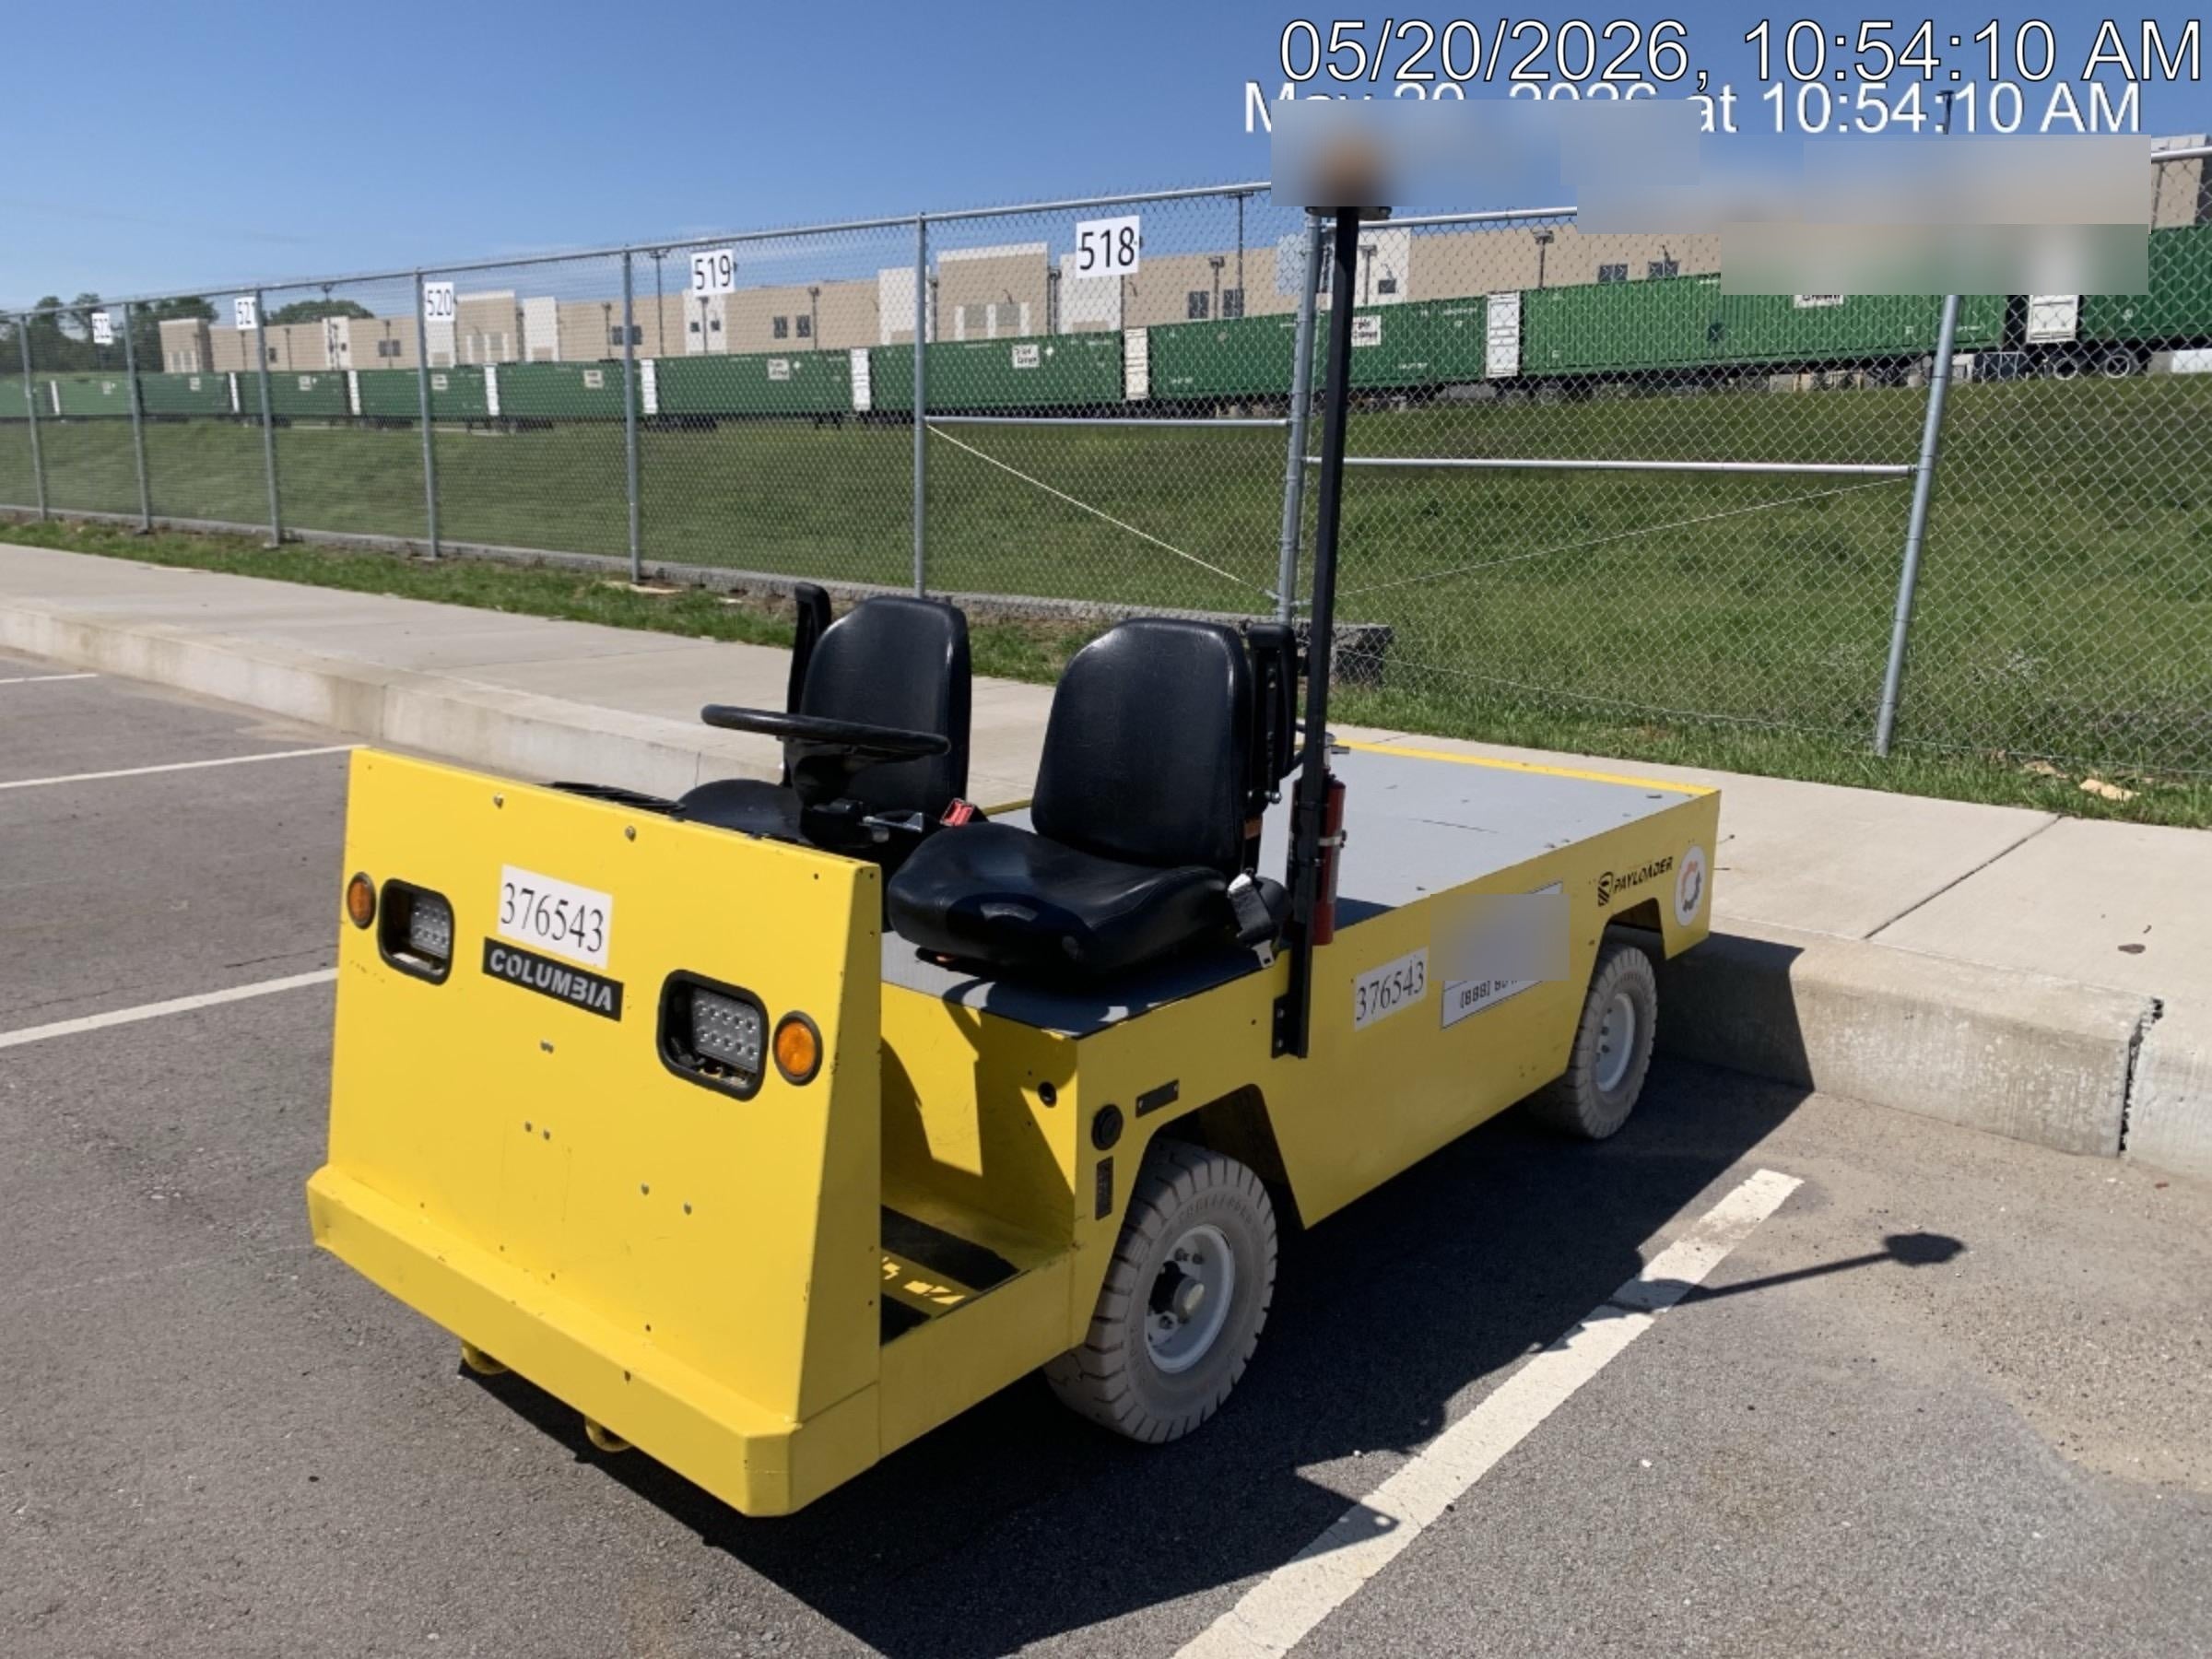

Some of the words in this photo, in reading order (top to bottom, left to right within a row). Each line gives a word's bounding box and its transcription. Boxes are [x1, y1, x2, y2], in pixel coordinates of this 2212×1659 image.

[1079, 226, 1135, 270] 518
[694, 254, 731, 290] 519
[427, 288, 453, 316] 520
[1613, 855, 1673, 894] PAYLOADER
[500, 882, 604, 953] 376543
[489, 947, 613, 1011] COLUMBIA
[1356, 959, 1424, 1021] 376543
